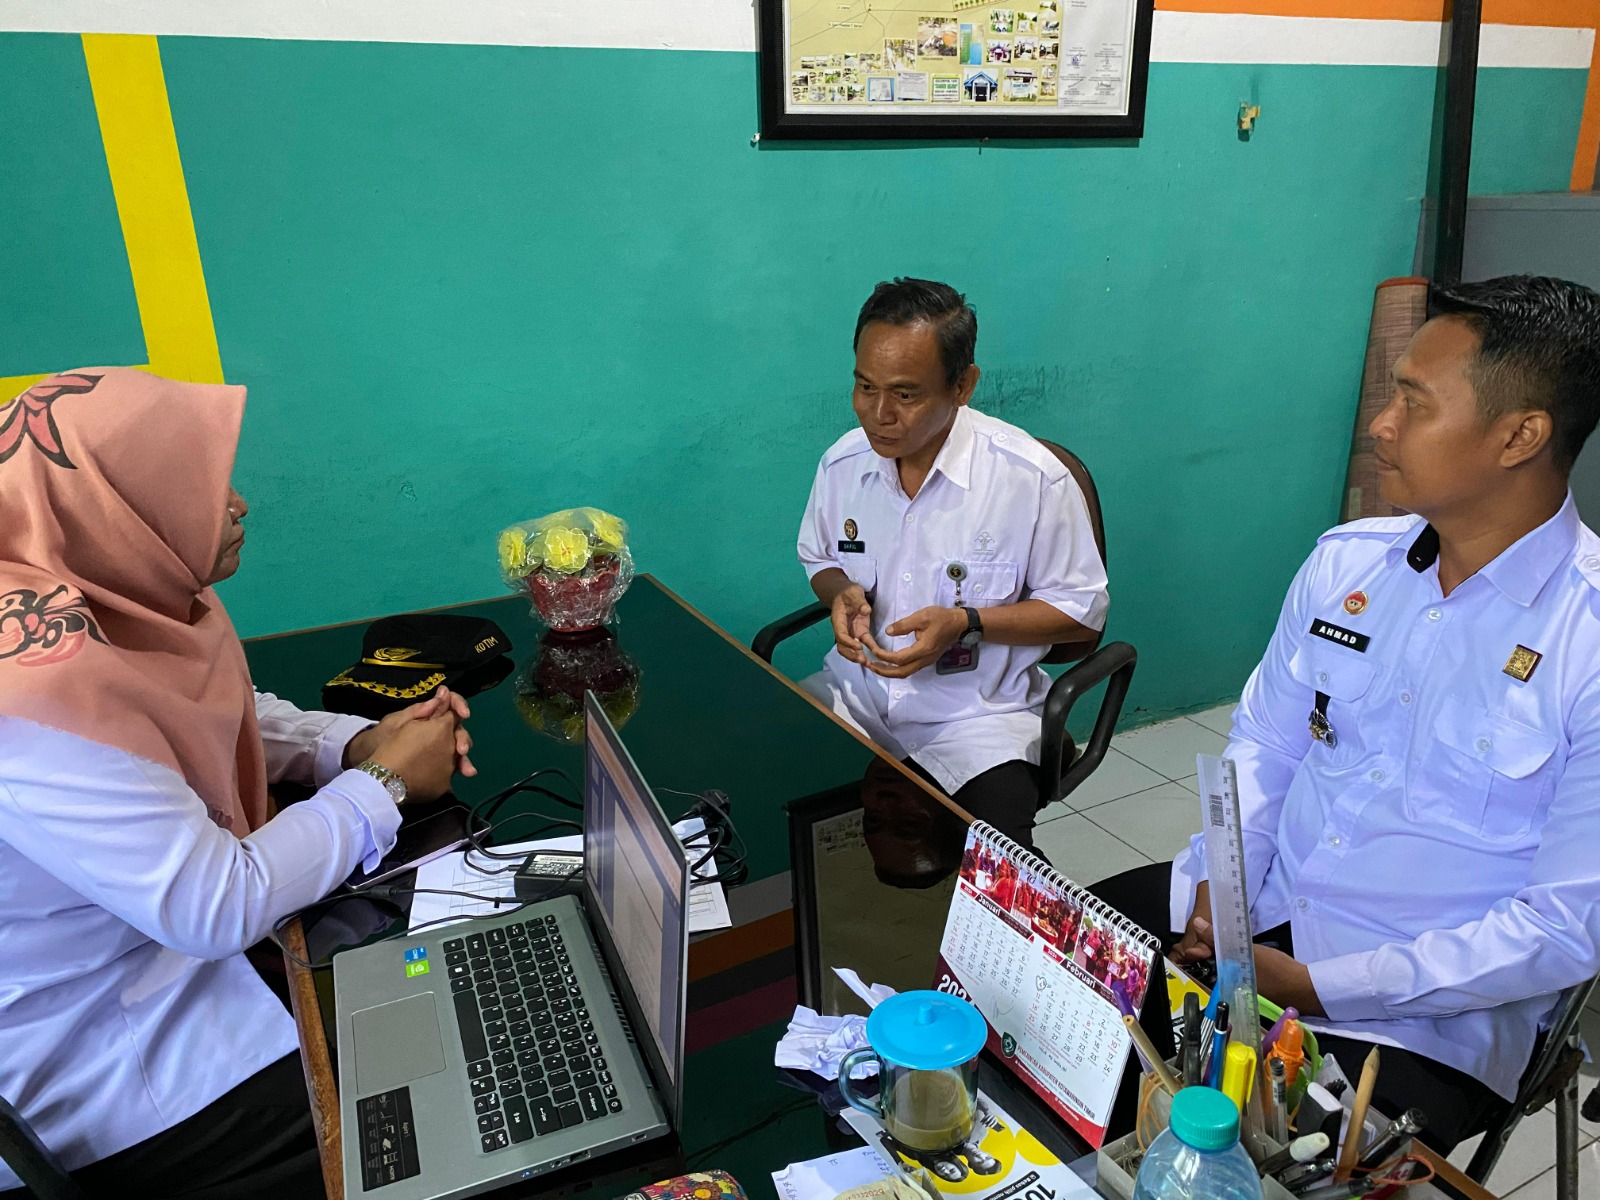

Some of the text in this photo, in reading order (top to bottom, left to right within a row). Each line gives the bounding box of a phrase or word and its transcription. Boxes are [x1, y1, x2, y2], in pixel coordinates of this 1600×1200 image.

[474, 636, 499, 654] KOTIM
[1318, 625, 1357, 644] AHMAD
[978, 895, 1001, 916] Januari
[1066, 961, 1096, 988] Februari
[936, 974, 974, 1003] 202
